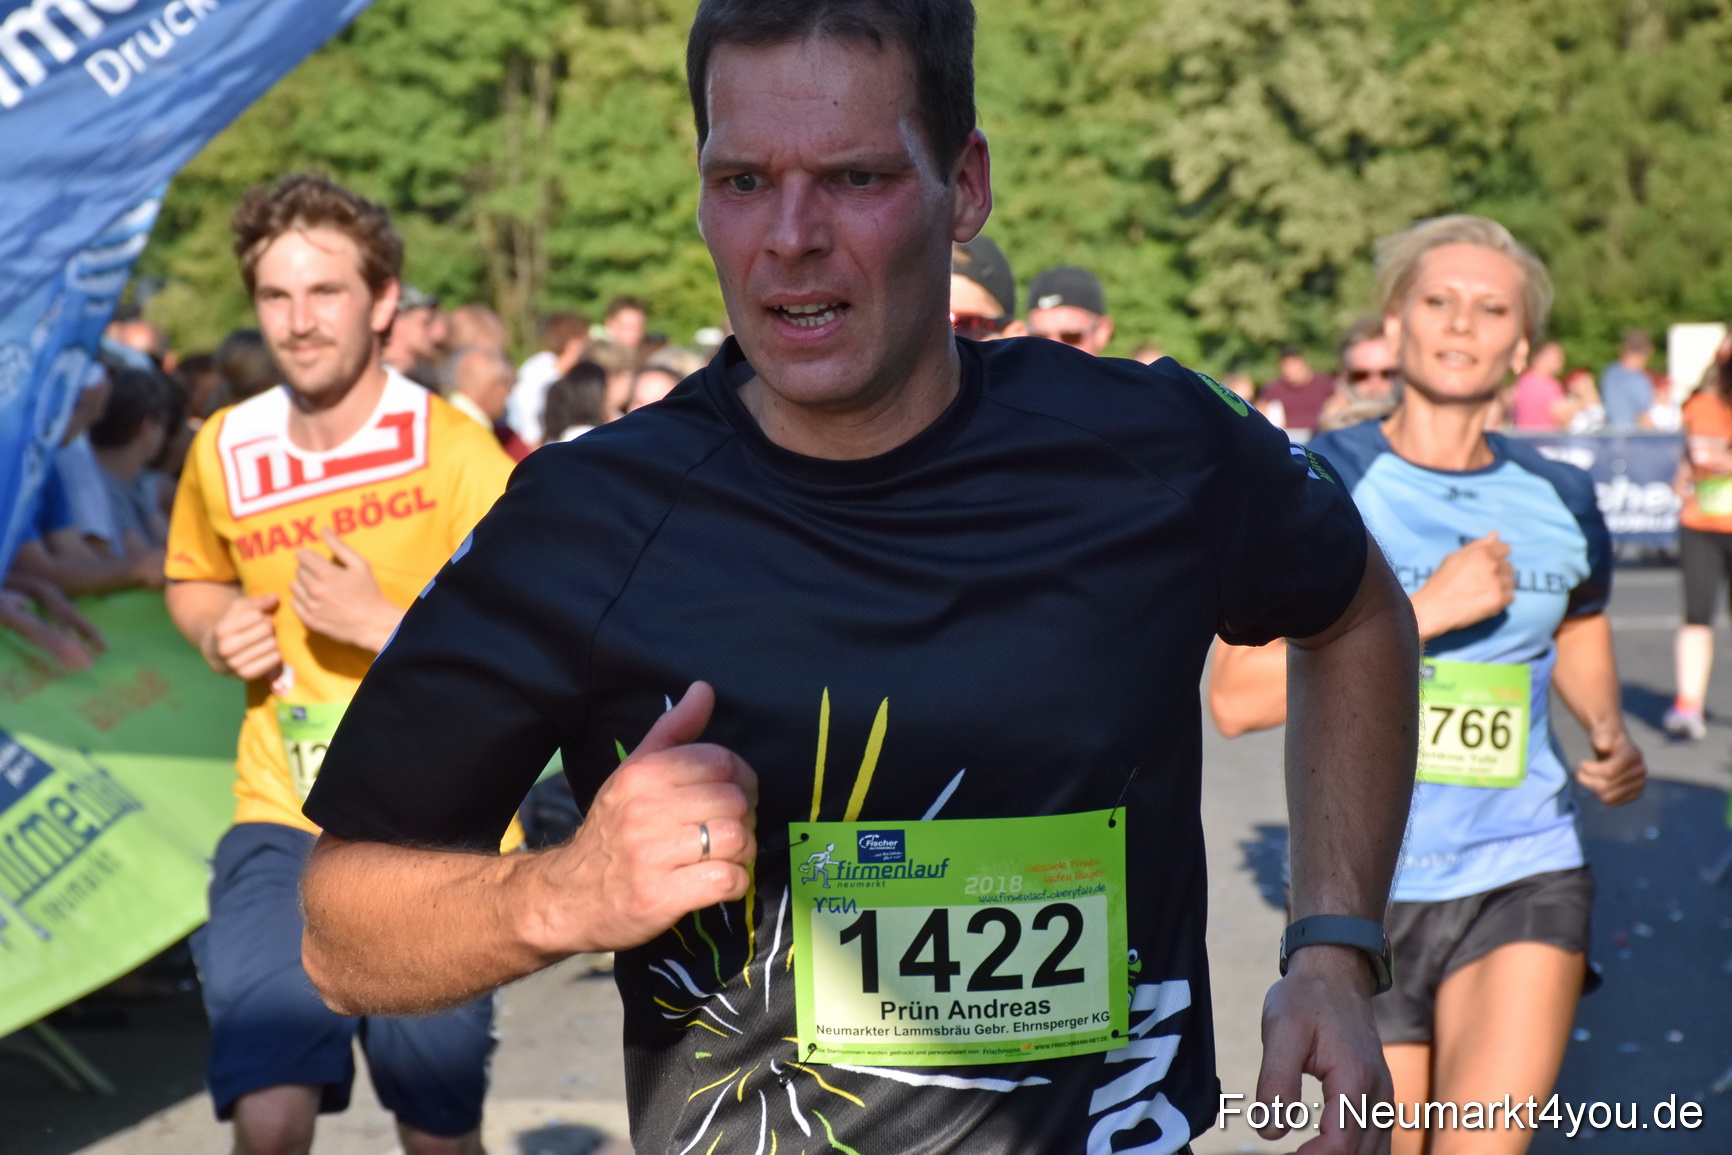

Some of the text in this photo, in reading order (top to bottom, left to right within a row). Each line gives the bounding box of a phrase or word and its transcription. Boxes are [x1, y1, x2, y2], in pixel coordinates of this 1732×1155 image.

[234, 487, 437, 562] MAX BÖGL
[291, 743, 329, 779] 12
[837, 858, 950, 878] firmenlauf
[837, 880, 886, 888] neumarkt
[964, 875, 1023, 895] 2018
[840, 902, 1085, 993] 1422
[881, 999, 1051, 1020] Prün Andreas
[816, 1011, 1110, 1036] Neumarkter Lammsbräu Gebr. Ehrnsperger KG
